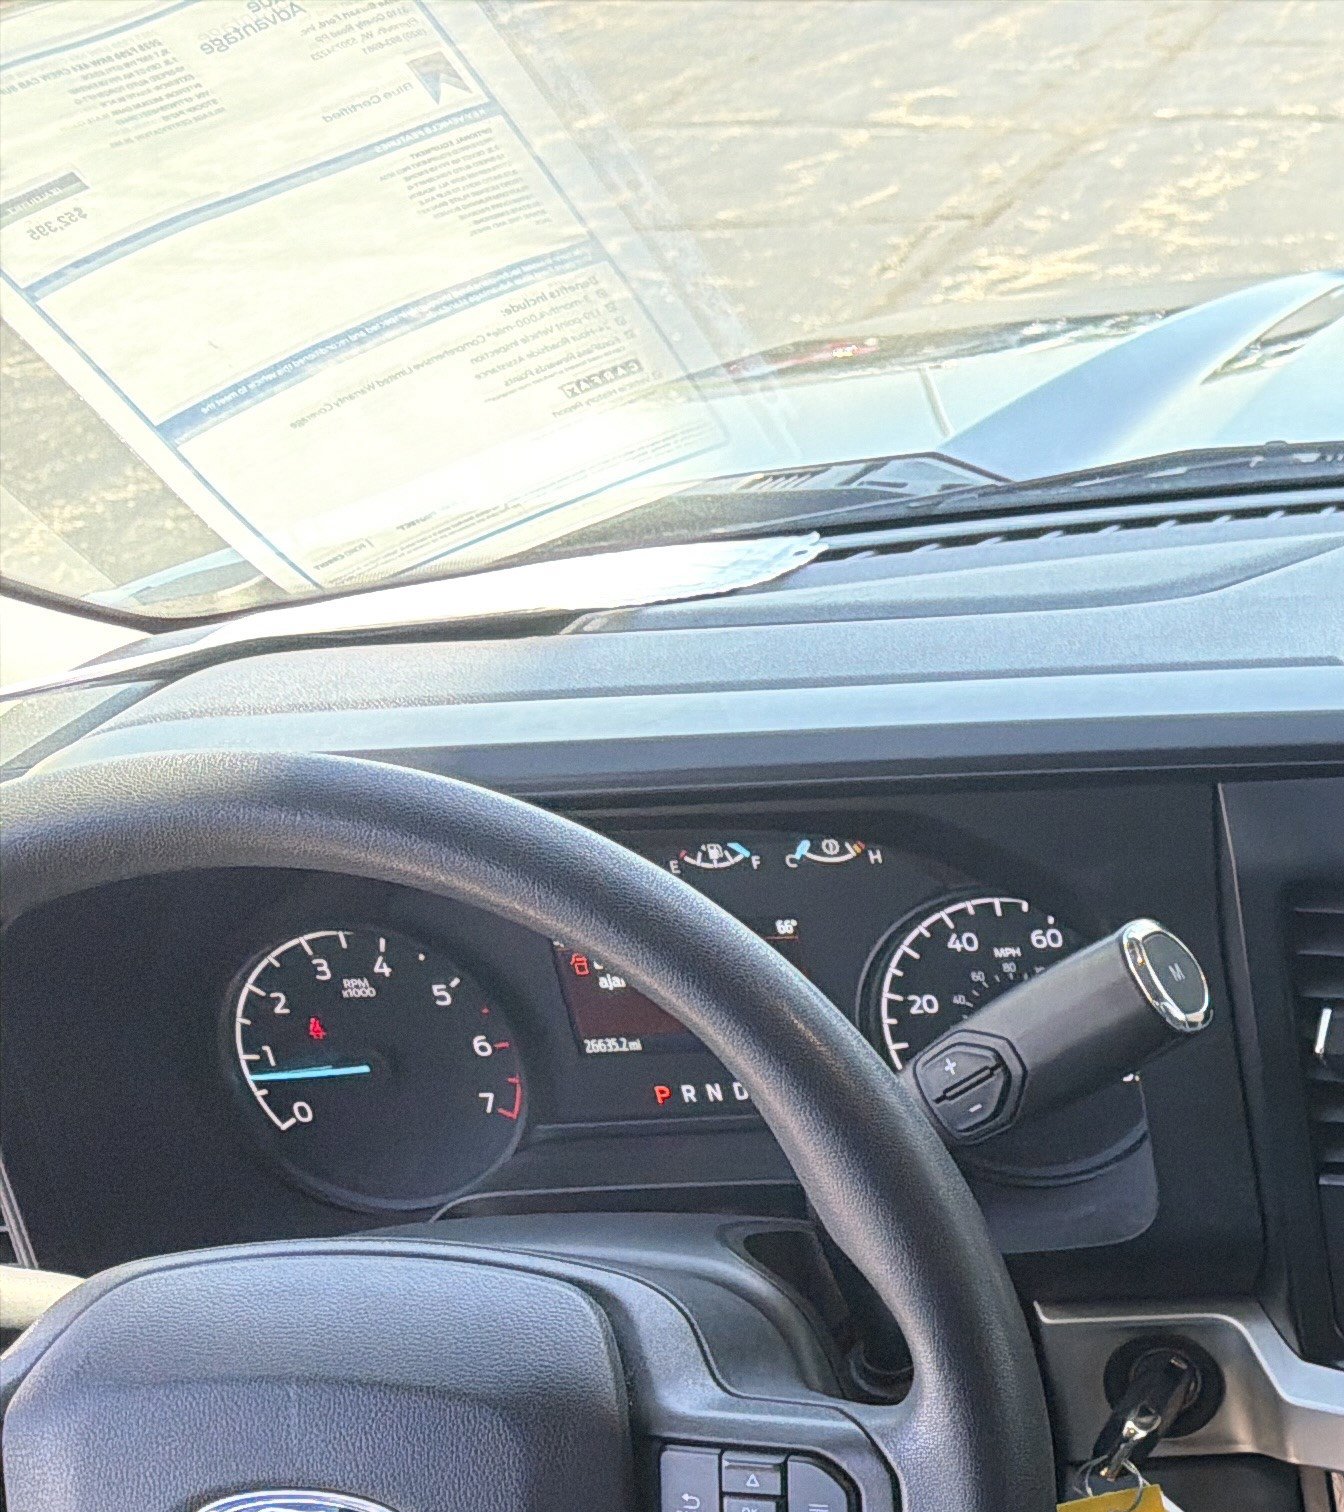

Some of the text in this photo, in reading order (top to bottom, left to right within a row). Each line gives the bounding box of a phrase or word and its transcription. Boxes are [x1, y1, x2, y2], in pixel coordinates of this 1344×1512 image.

[669, 860, 682, 874] E
[751, 857, 762, 869] F
[785, 855, 799, 869] C
[868, 850, 883, 865] H
[947, 932, 980, 952] 40
[1031, 929, 1063, 949] 60
[992, 946, 1022, 959] MPH
[311, 958, 332, 980] 3
[373, 955, 392, 977] 4
[342, 977, 370, 988] RPM
[269, 992, 291, 1014] 2
[431, 984, 452, 1006] 5
[907, 994, 939, 1014] 20
[261, 1045, 276, 1066] 1
[472, 1035, 493, 1057] 6
[478, 1092, 495, 1113] 7
[653, 1082, 748, 1104] P R N D
[292, 1101, 313, 1122] 0
